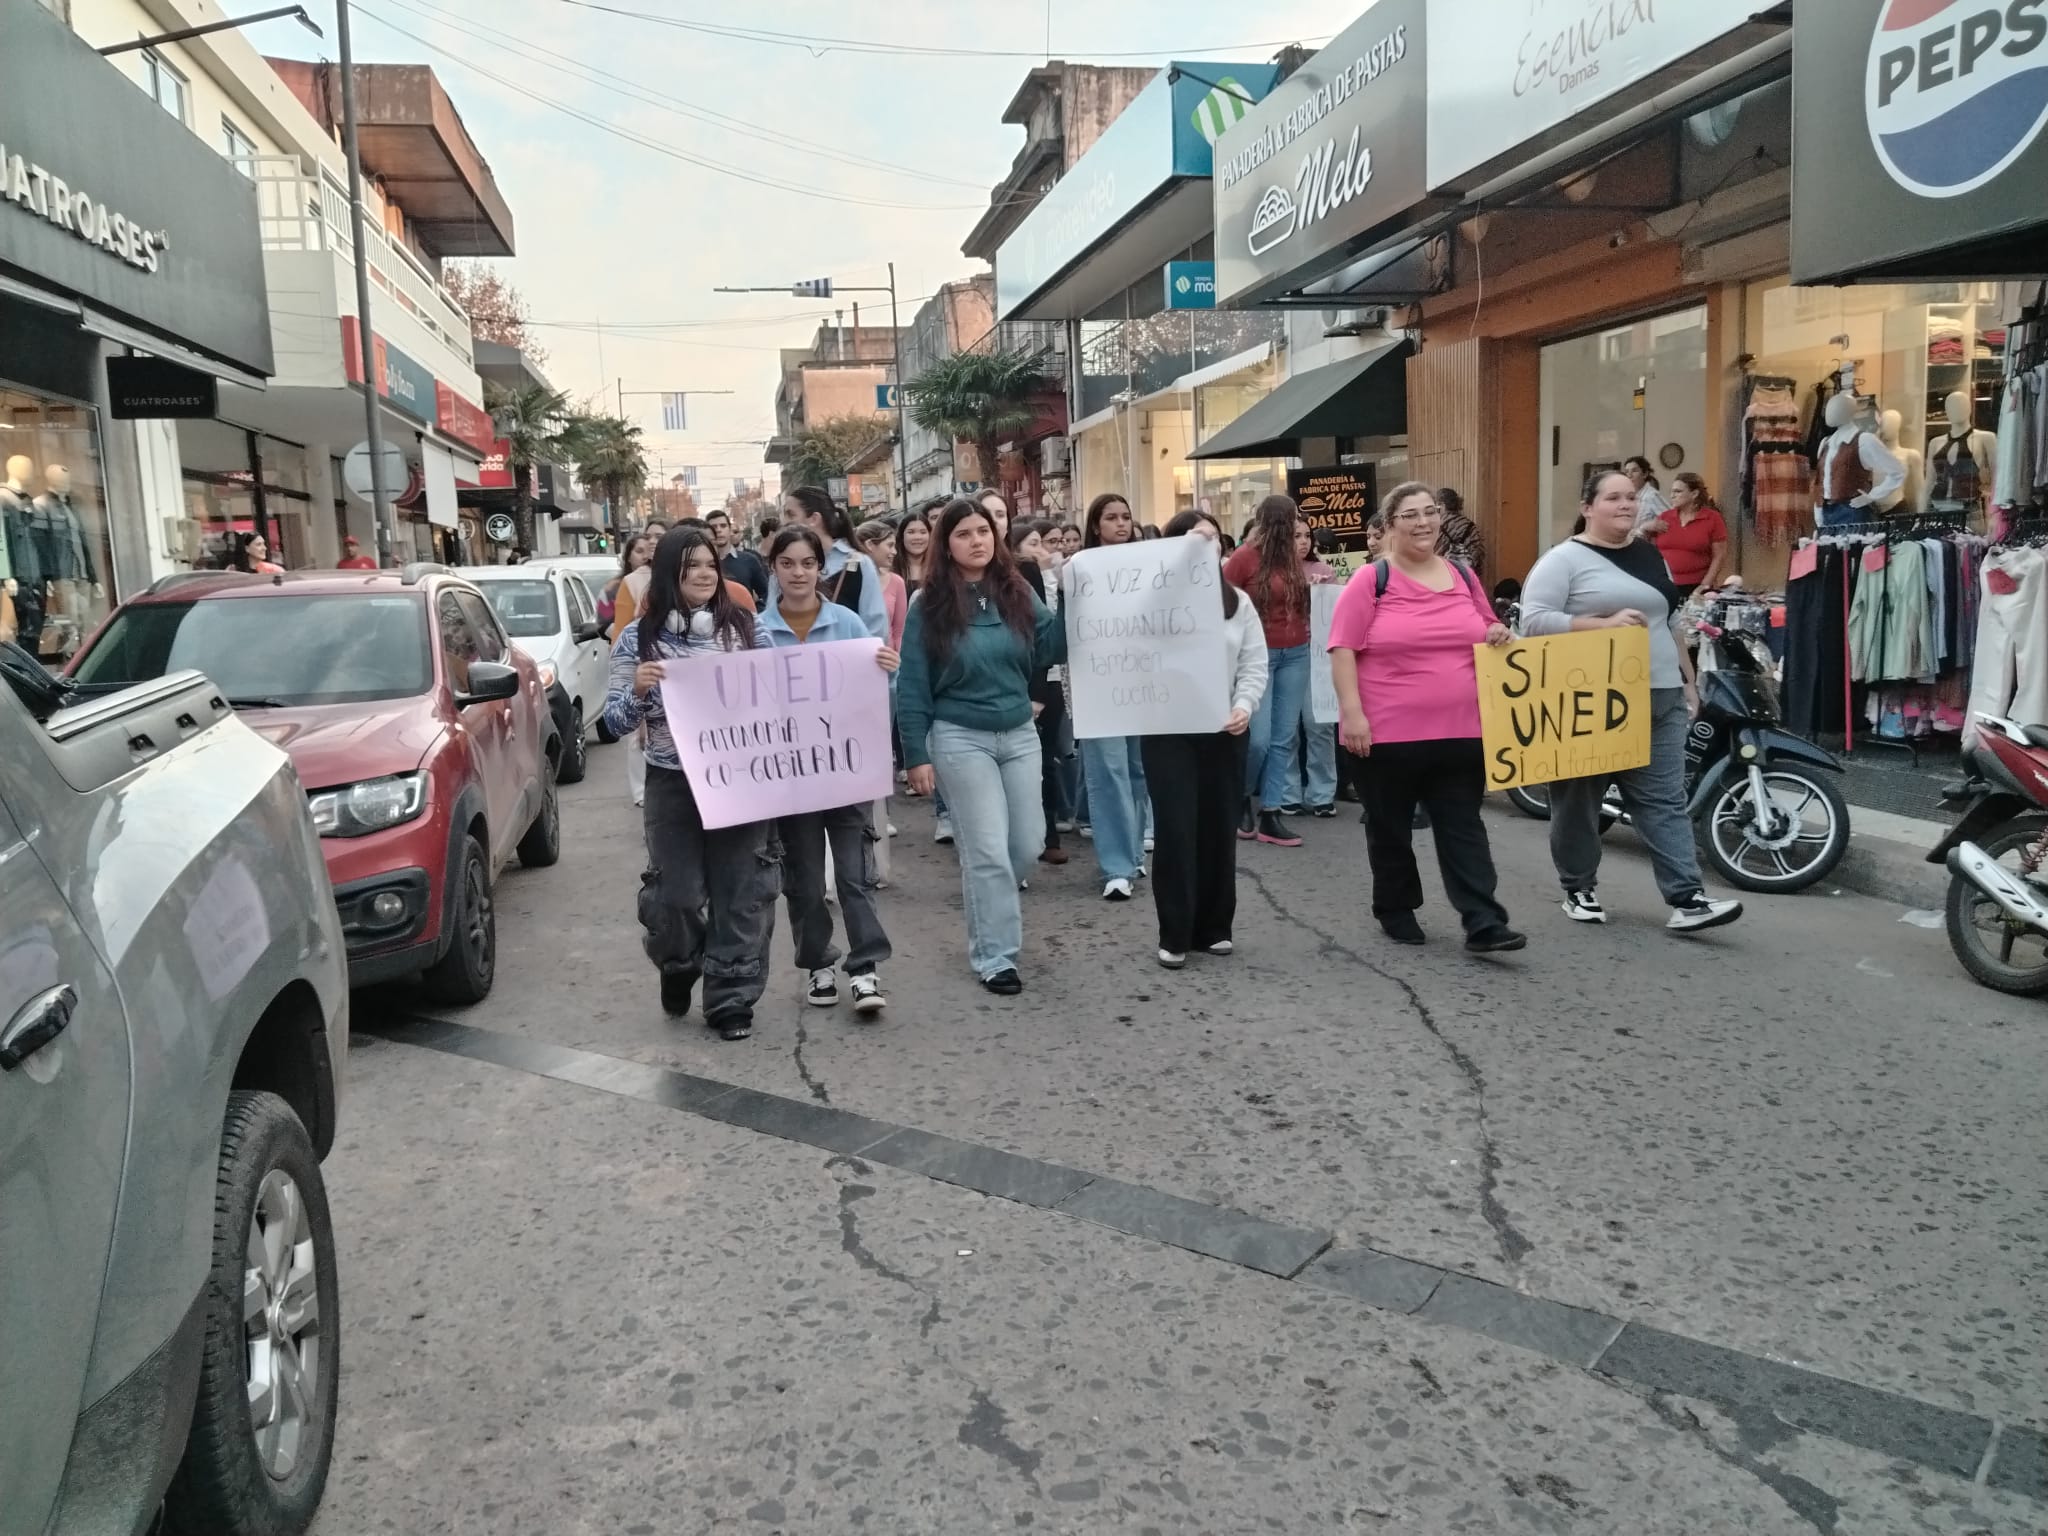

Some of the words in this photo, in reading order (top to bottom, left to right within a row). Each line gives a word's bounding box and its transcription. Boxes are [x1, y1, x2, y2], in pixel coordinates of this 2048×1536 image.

[1559, 60, 1600, 95] Damas
[1222, 124, 1276, 190] PANADERÍA
[1276, 121, 1286, 151] &
[1286, 83, 1336, 143] FABRICA
[1335, 66, 1354, 106] DE
[1355, 24, 1407, 90] PASTAS
[1295, 124, 1373, 230] Melo
[0, 144, 157, 272] ATROASES
[1194, 282, 1216, 293] mo
[123, 397, 201, 407] CUATROASES
[1326, 492, 1366, 511] Melo
[1330, 484, 1340, 492] DE
[1342, 482, 1367, 491] PASTAS
[1152, 560, 1175, 590] de
[1566, 667, 1594, 689] a
[1607, 638, 1648, 685] la
[714, 650, 845, 711] UNED
[818, 716, 833, 739] Y
